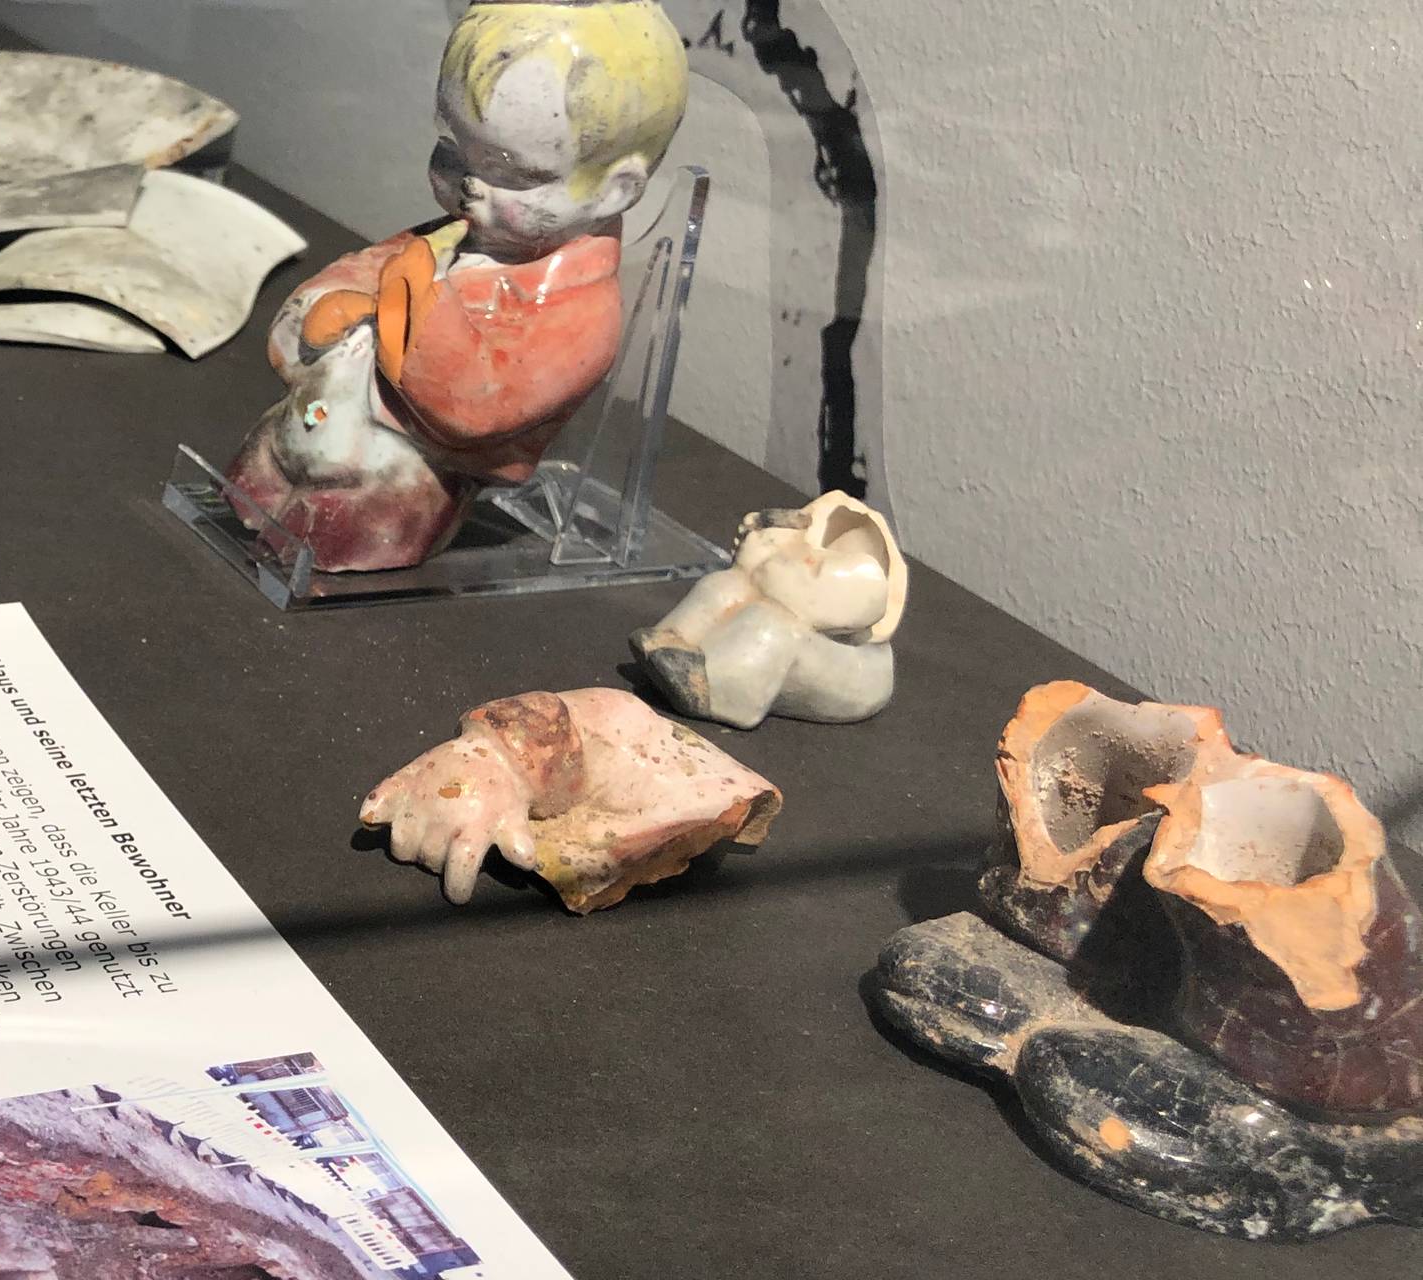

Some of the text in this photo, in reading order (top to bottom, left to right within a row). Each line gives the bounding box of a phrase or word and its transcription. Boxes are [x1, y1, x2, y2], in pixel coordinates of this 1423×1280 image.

[0, 768, 46, 820] zeigen,
[41, 824, 78, 858] dass
[68, 862, 98, 886] die
[88, 889, 138, 937] Keller
[124, 941, 159, 968] bis
[148, 971, 179, 994] zu
[10, 698, 47, 726] und
[32, 729, 74, 770] seine
[64, 772, 119, 829] letzten
[110, 832, 192, 920] Bewohner
[28, 858, 95, 926] 1943/44
[74, 930, 144, 999] genutzt
